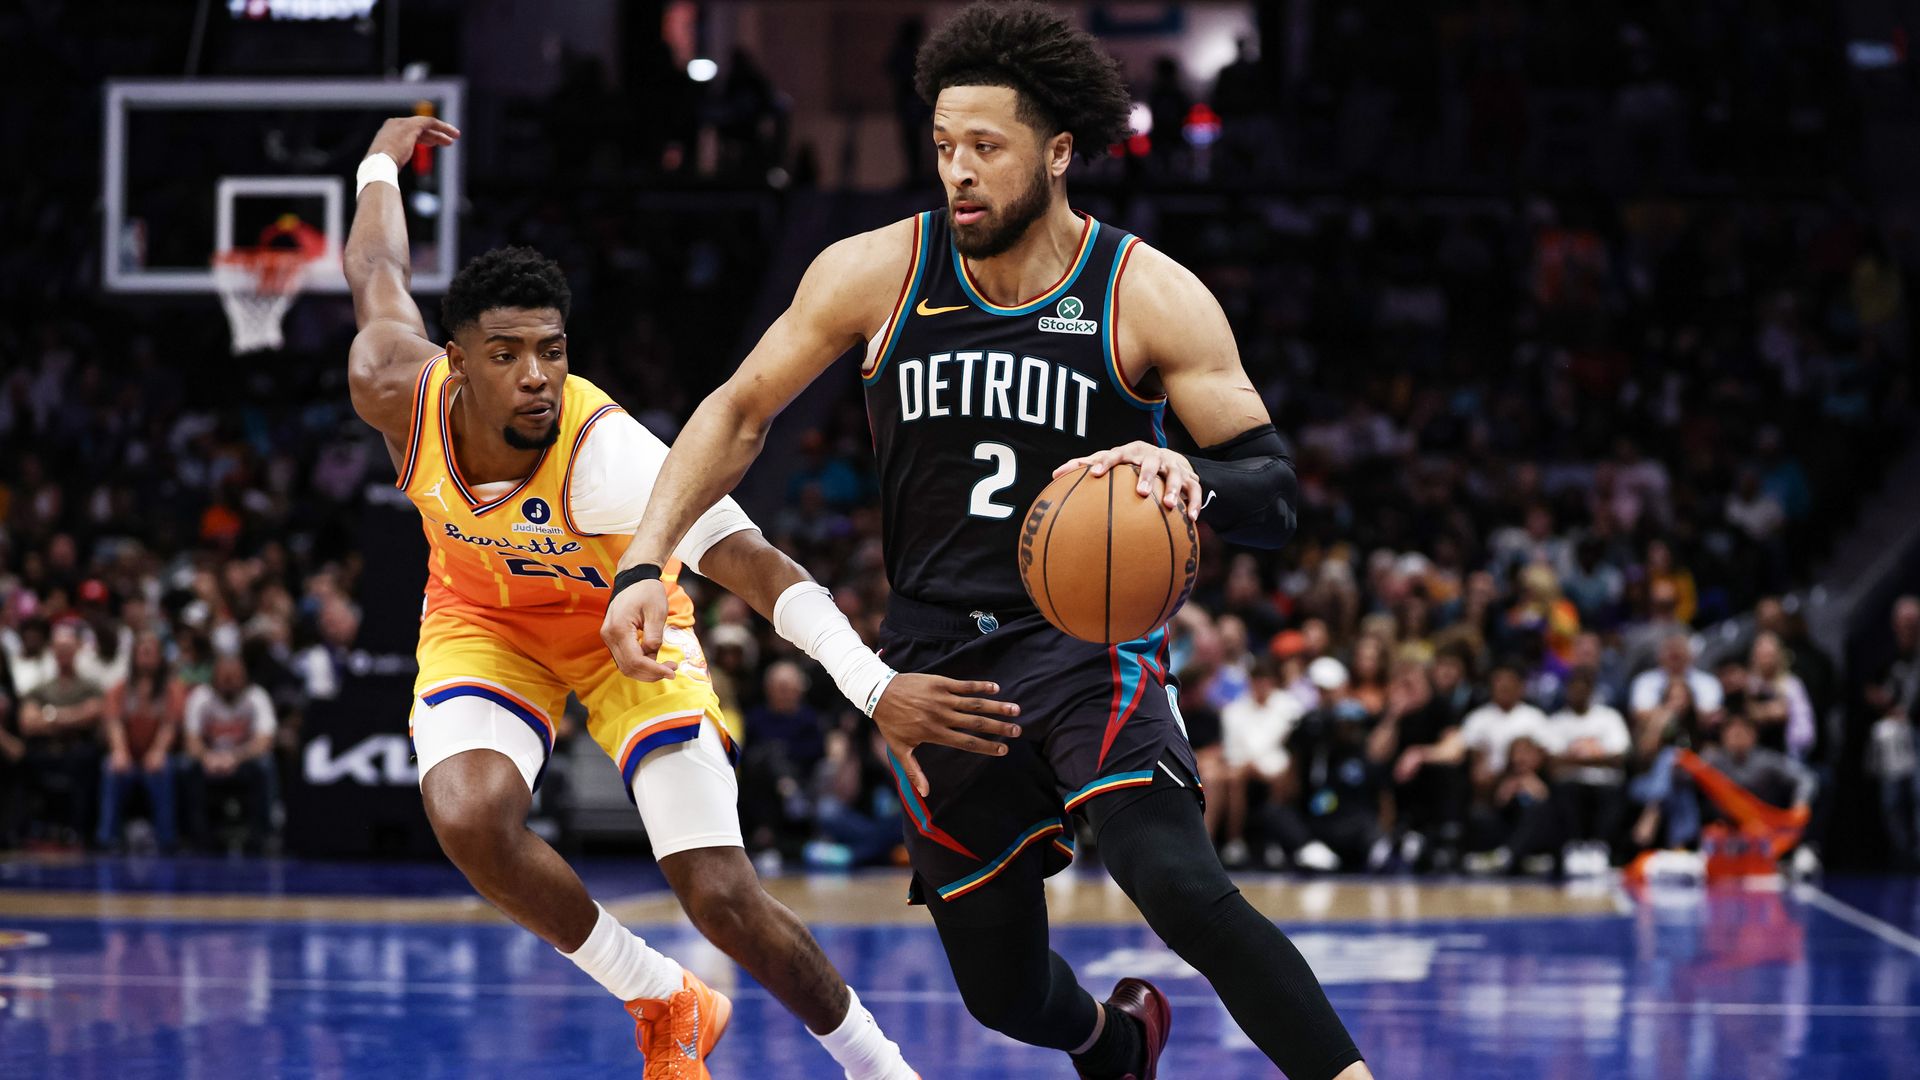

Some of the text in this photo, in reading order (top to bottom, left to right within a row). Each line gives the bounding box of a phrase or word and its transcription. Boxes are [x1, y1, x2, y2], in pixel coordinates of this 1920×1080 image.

[1040, 318, 1095, 333] StockX
[898, 351, 1098, 438] DETROIT
[969, 441, 1017, 520] 2
[444, 522, 581, 556] harlotte
[497, 551, 610, 588] 24
[304, 733, 420, 786] KI
